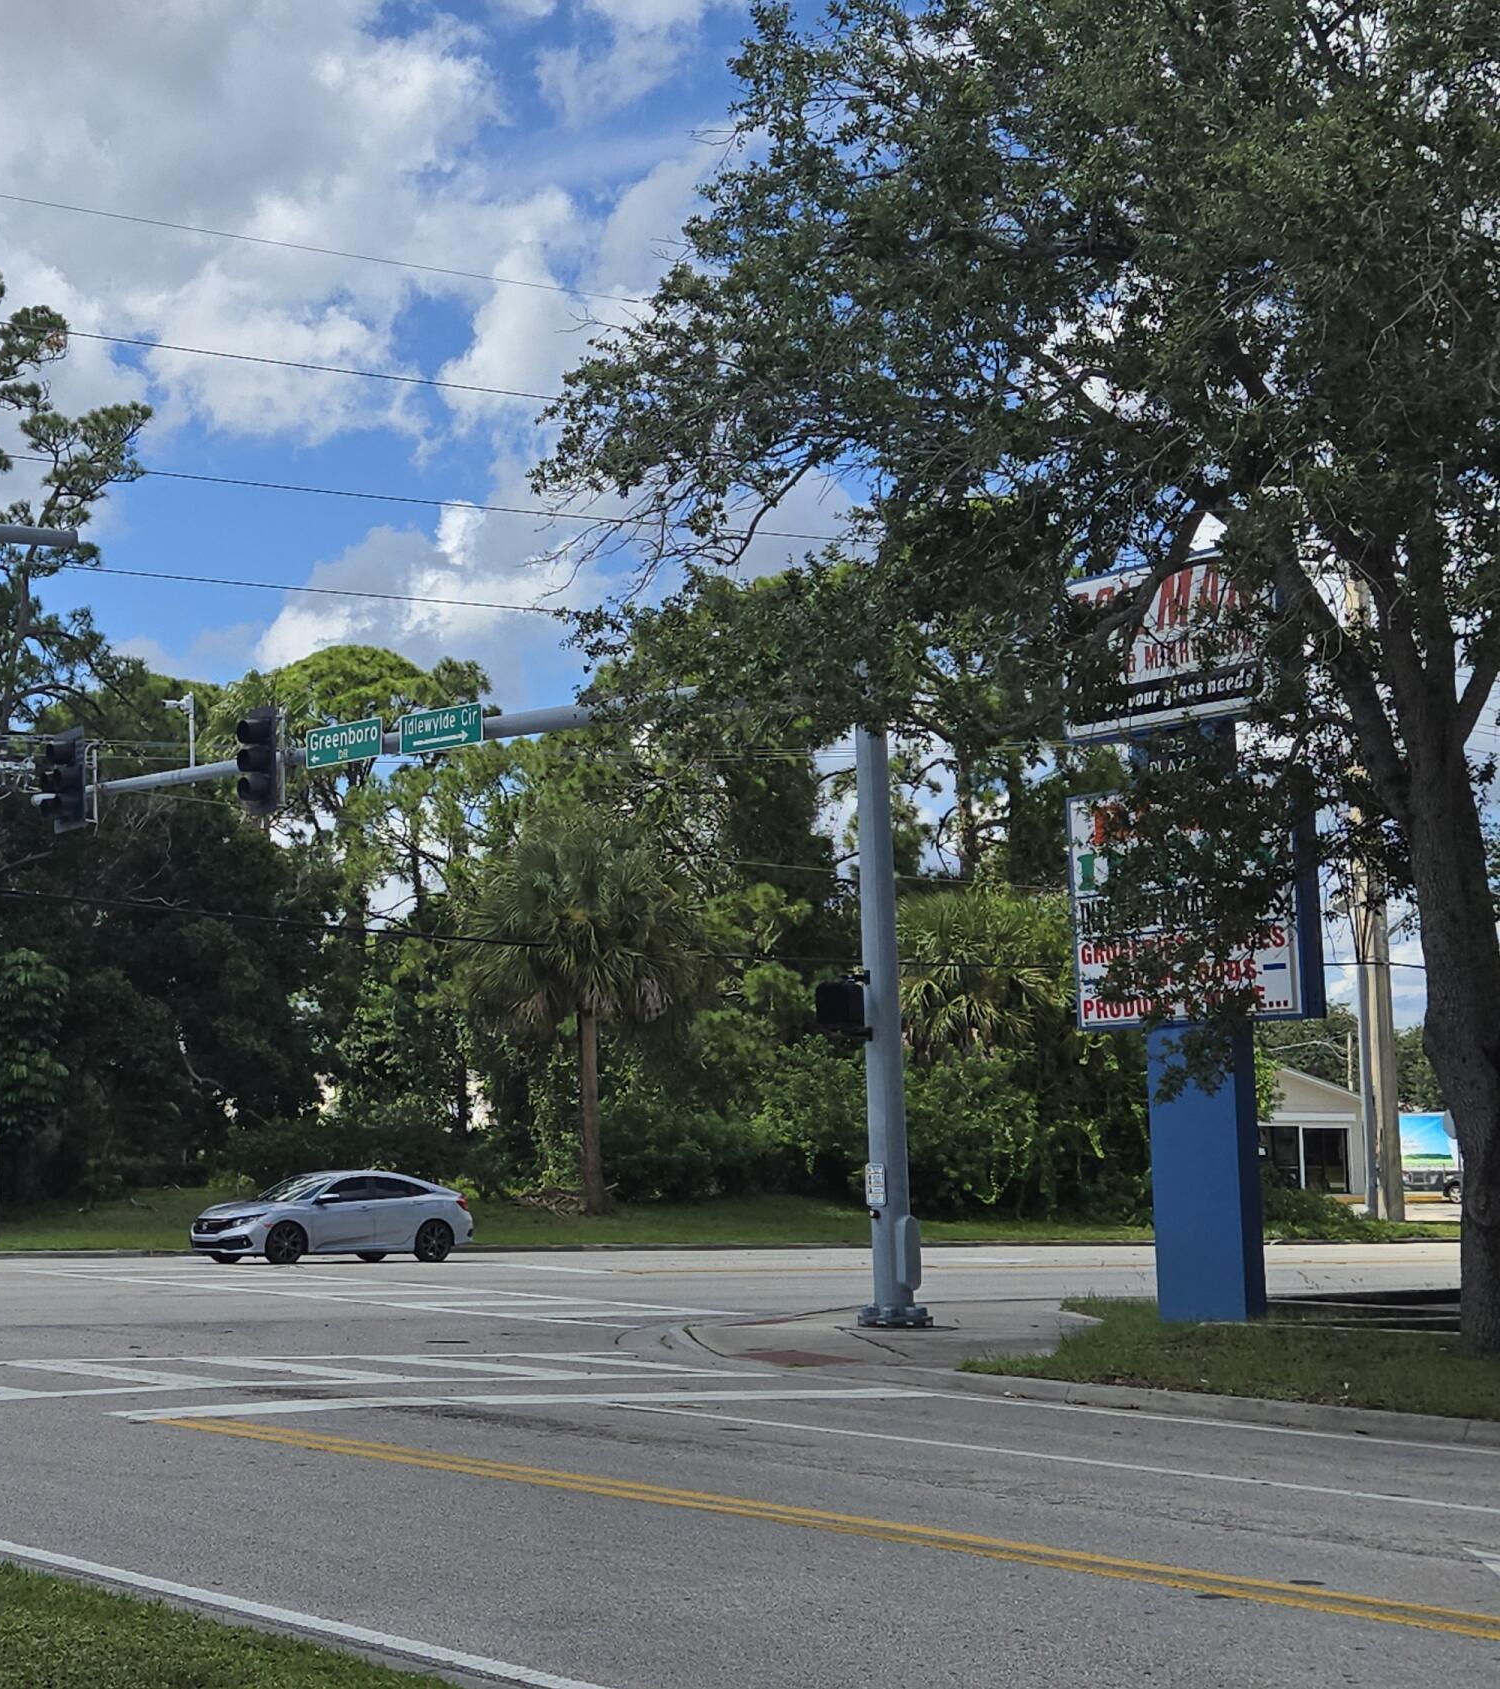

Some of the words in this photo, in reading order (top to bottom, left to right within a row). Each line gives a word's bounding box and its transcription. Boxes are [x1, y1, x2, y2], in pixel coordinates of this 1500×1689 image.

[1128, 690, 1161, 708] your
[404, 714, 456, 736] Idlewylde
[461, 708, 478, 727] Cir
[310, 725, 378, 751] Greenboro
